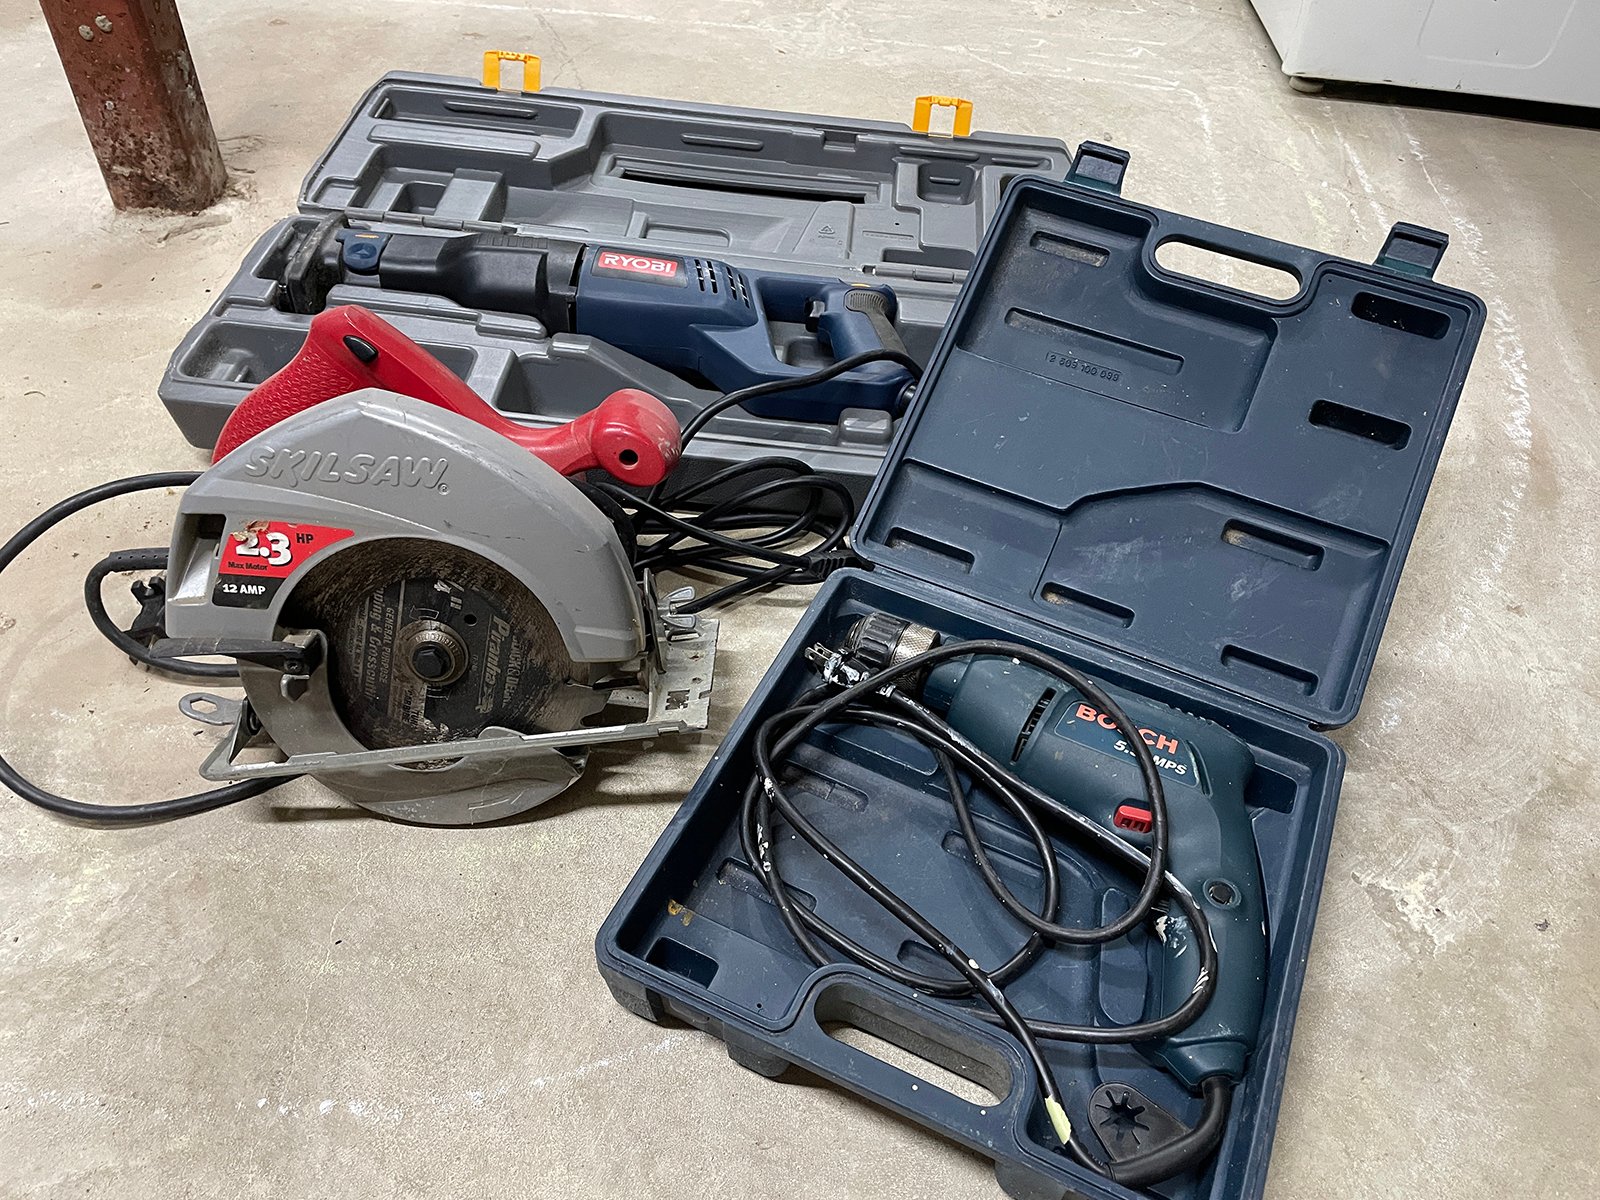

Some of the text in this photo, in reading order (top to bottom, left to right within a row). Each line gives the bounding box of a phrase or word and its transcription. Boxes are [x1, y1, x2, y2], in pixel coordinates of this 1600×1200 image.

[604, 254, 672, 273] RYOBI
[228, 561, 268, 571] Max Motor
[235, 531, 314, 566] 2.3 HP
[222, 583, 266, 595] 12 AMP
[380, 607, 395, 683] GENERAL PURPOSE
[485, 615, 511, 685] Piranha
[1075, 703, 1179, 755] BOCH
